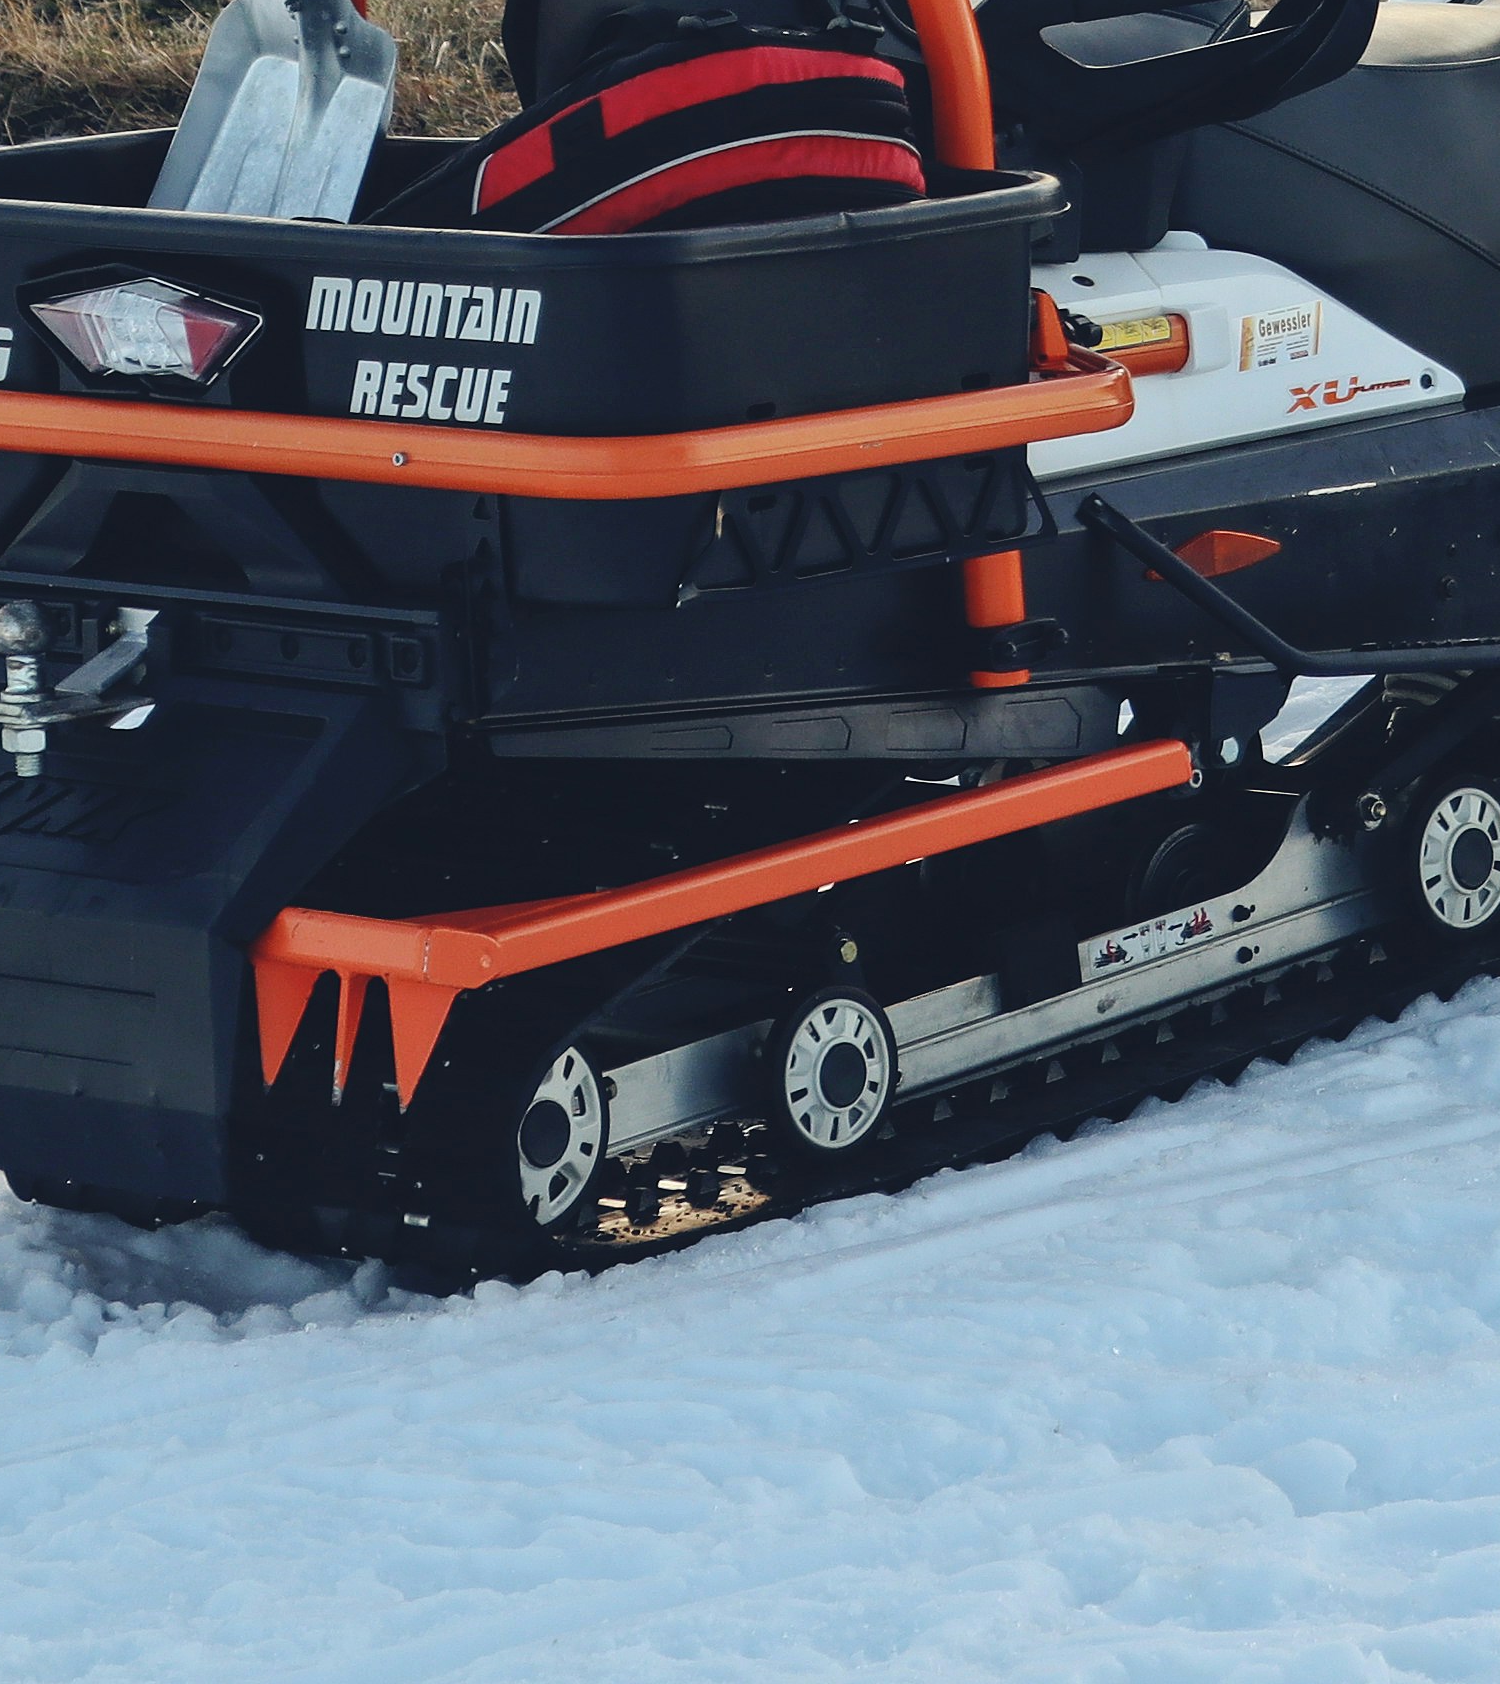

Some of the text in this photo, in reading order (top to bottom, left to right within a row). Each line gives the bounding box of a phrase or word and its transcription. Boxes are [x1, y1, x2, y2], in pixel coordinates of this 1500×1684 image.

[1258, 310, 1311, 338] Gewessler
[350, 360, 512, 424] RESCUE
[1286, 376, 1359, 414] XU
